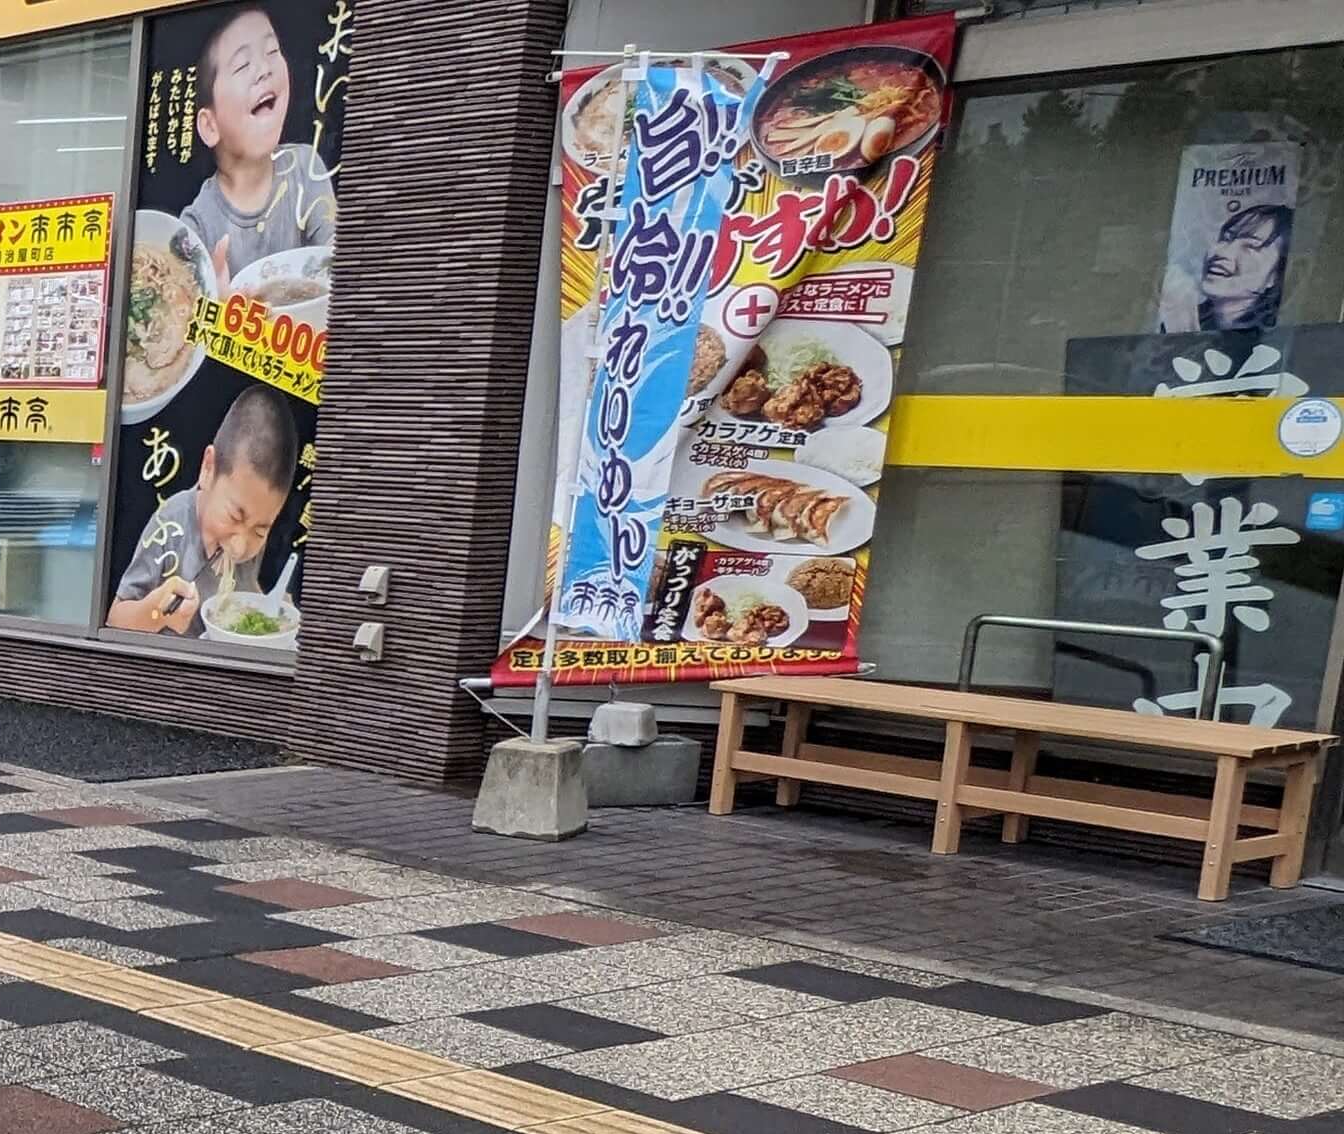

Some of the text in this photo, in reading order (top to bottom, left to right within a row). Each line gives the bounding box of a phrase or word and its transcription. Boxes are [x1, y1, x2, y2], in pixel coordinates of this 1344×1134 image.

[179, 66, 197, 164] こんな笑顔が
[1191, 164, 1288, 187] PREMIUM
[196, 296, 219, 324] 1日
[698, 421, 809, 446] カラアゲ定食
[665, 494, 756, 513] ギョーザ定食
